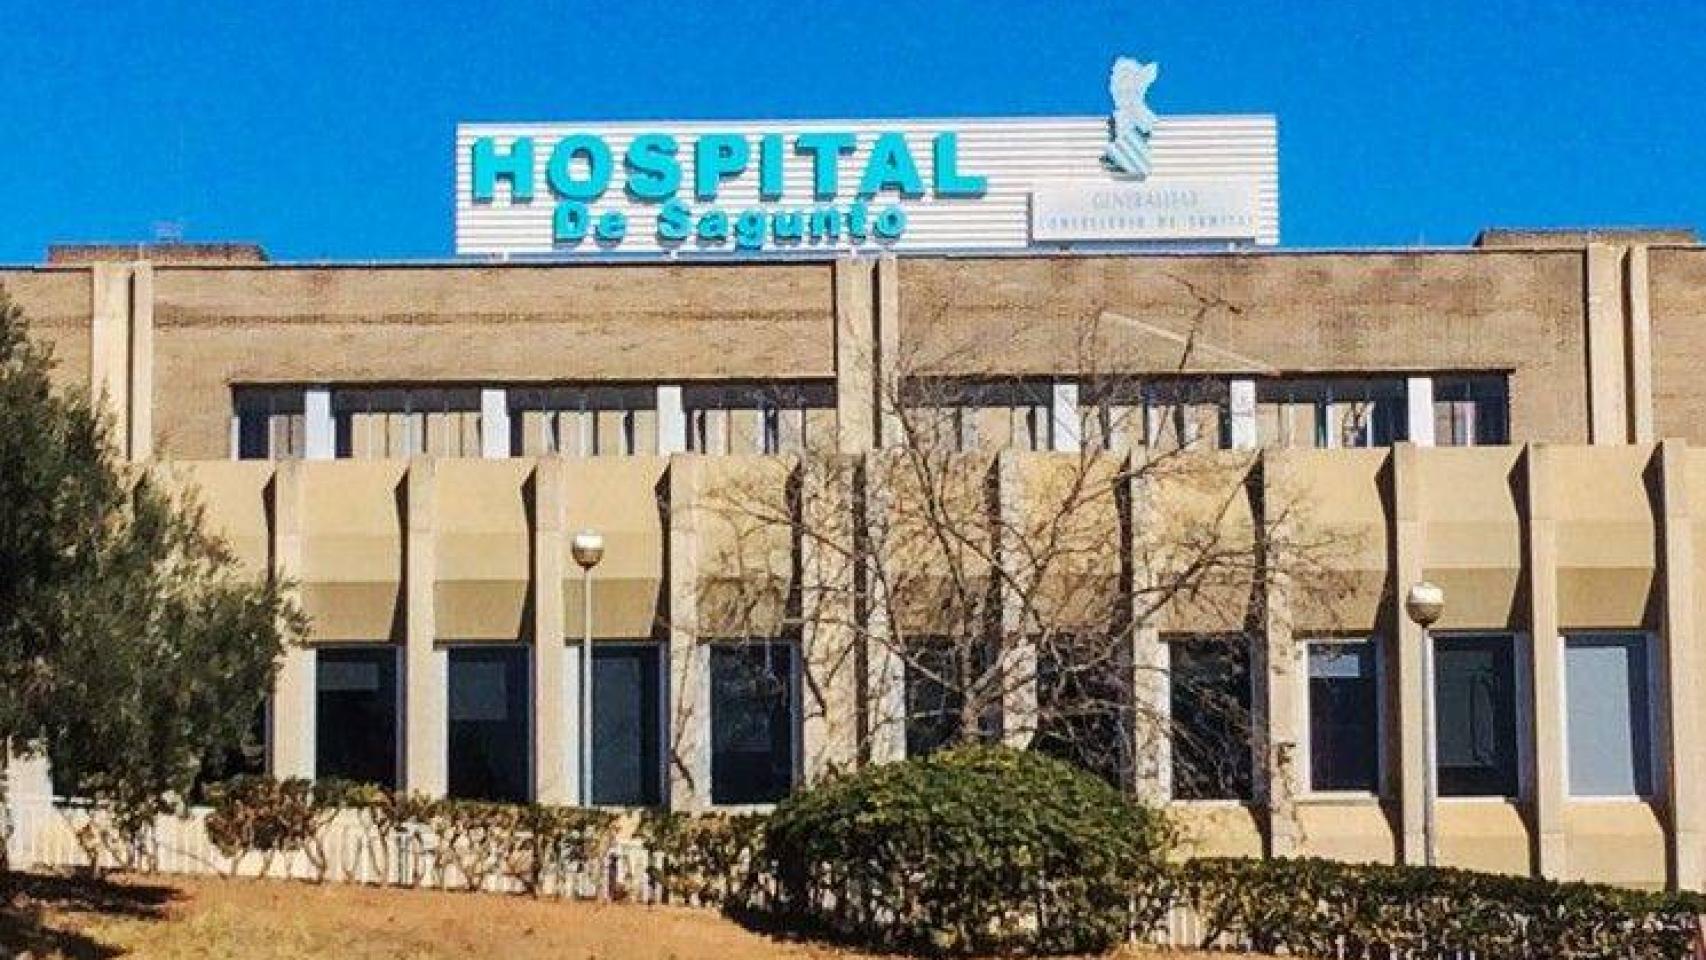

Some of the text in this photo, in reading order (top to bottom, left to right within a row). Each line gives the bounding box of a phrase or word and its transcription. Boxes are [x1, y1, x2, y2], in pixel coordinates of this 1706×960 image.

[471, 132, 988, 203] HOSPITAL
[553, 199, 906, 250] De Sagunto
